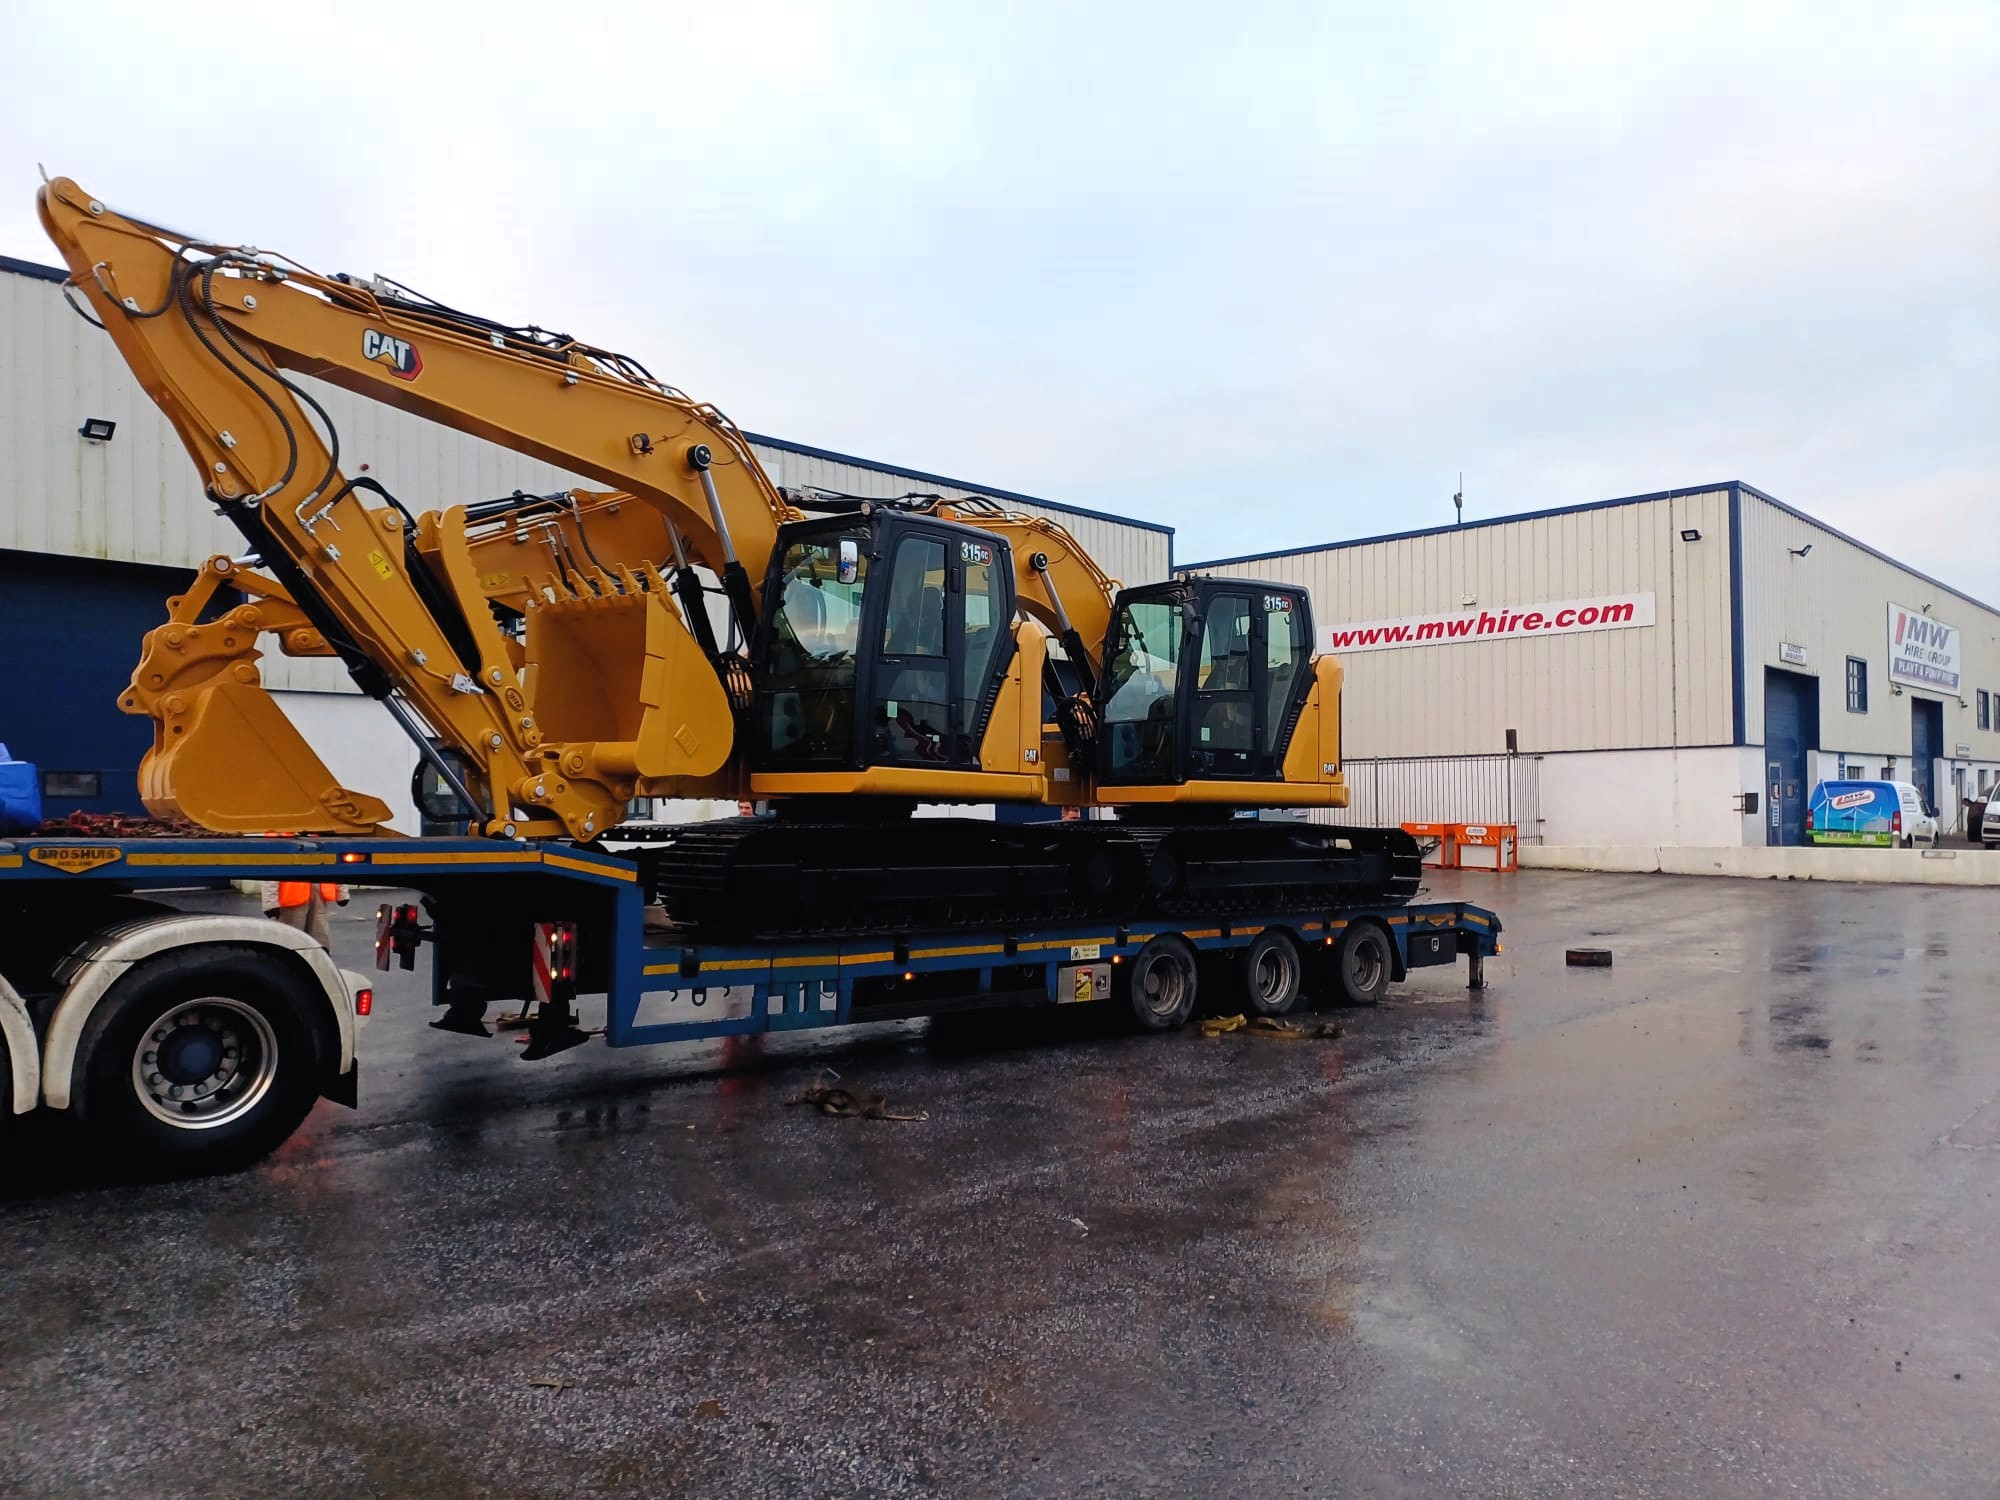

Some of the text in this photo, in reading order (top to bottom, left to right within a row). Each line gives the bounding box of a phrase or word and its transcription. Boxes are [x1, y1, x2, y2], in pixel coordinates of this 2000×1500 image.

[363, 329, 410, 370] CAT
[1331, 602, 1635, 648] www.mwhire.com
[1907, 616, 1951, 650] MW
[1904, 643, 1951, 667] HIRE GROUP
[1898, 660, 1918, 676] PLANT
[1024, 749, 1037, 762] CAT
[1323, 763, 1335, 775] CAT
[38, 848, 115, 859] BROSHUIS
